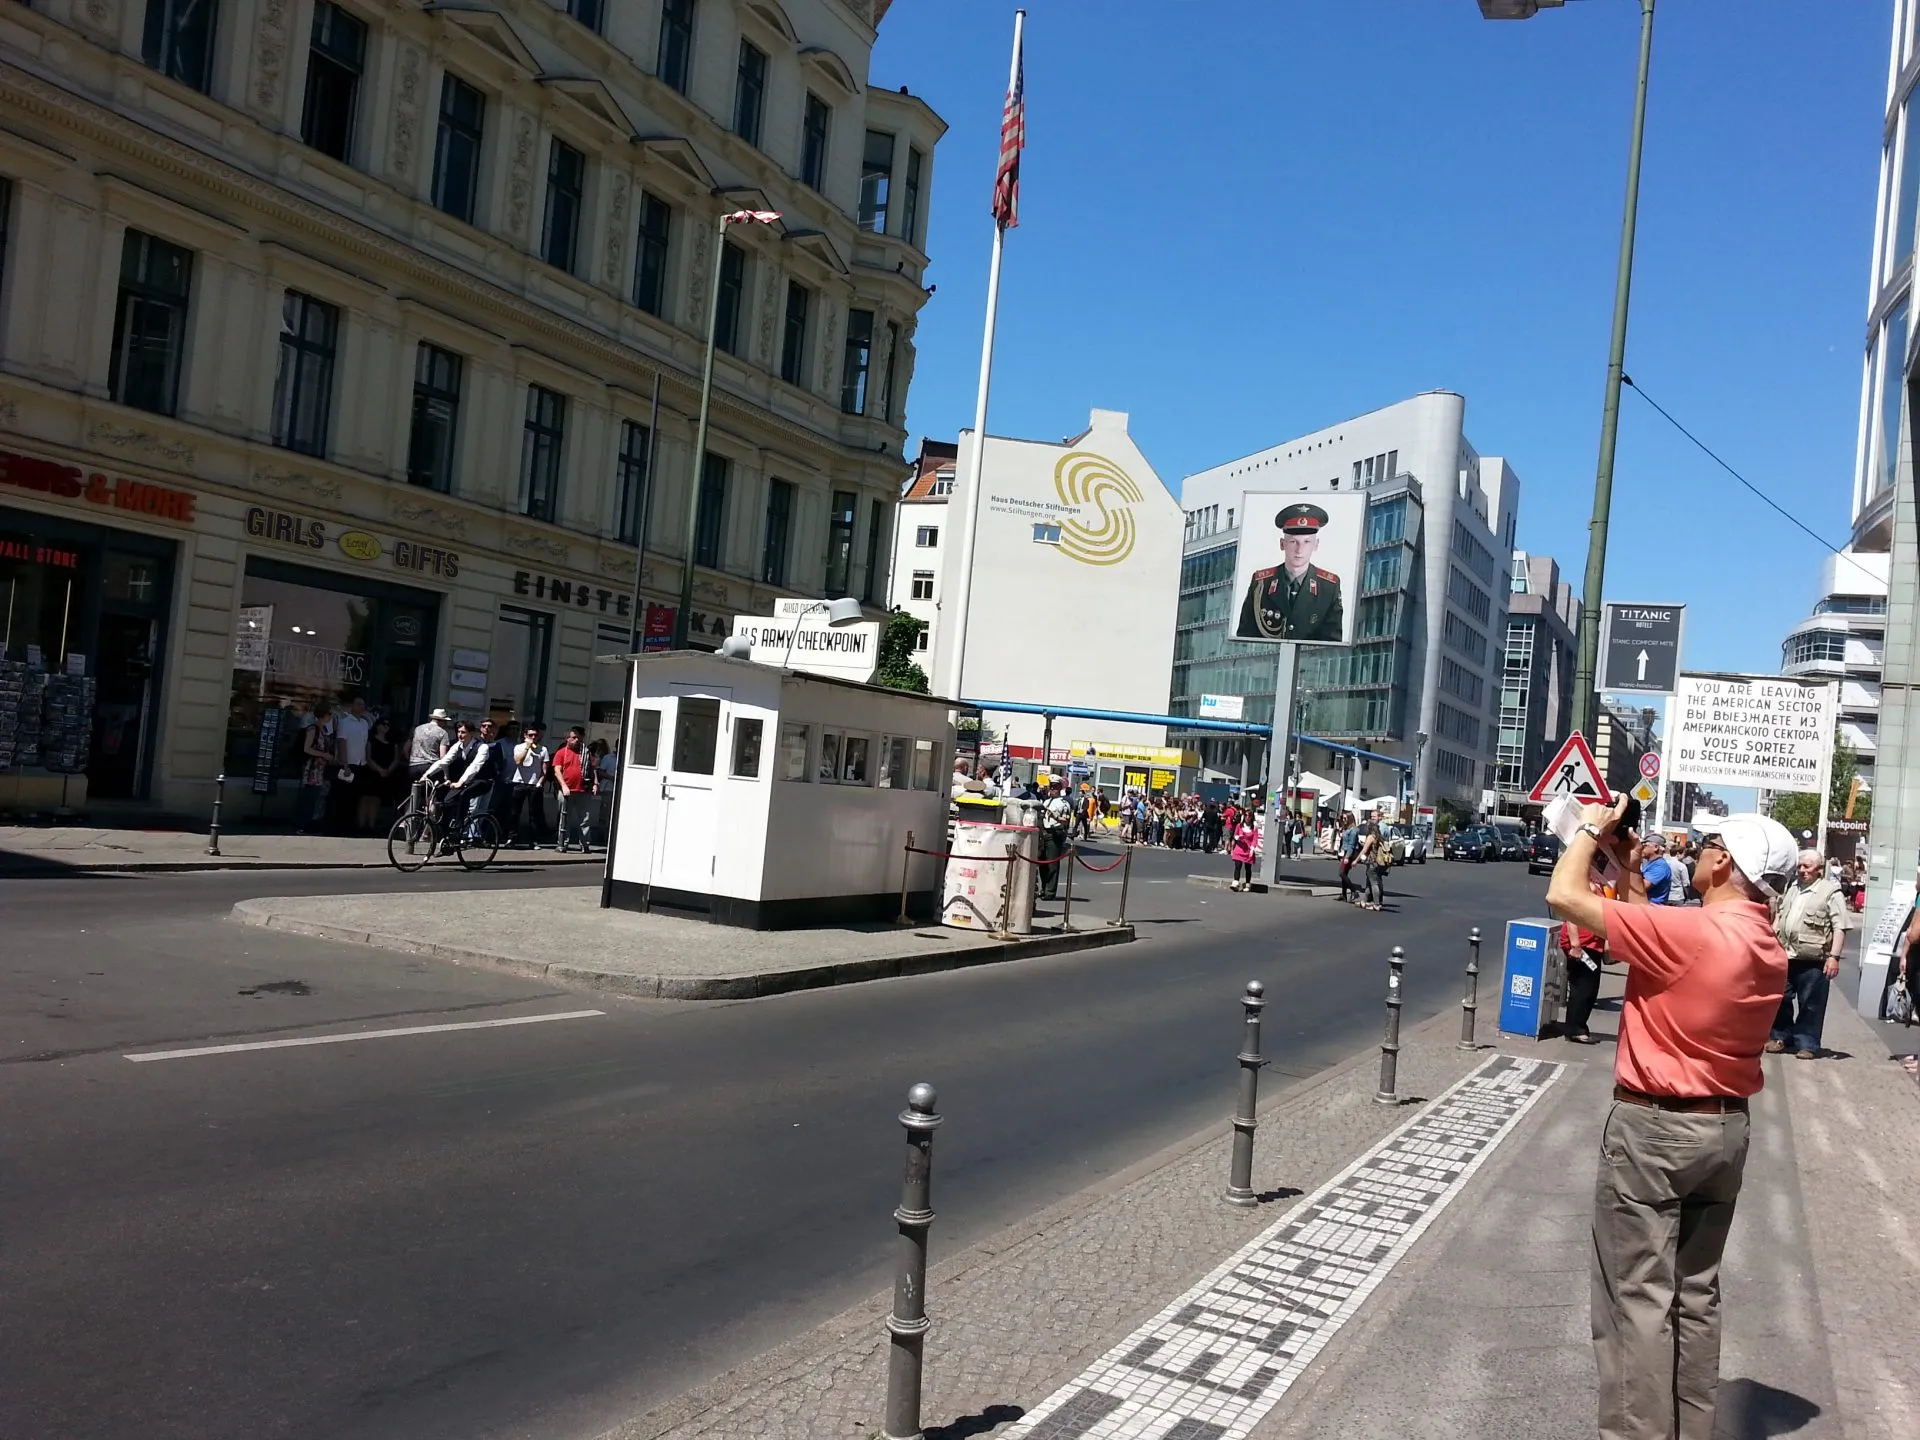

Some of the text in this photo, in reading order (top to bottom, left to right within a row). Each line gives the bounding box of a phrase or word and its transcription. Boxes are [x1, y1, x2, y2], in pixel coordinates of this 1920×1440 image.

[85, 473, 110, 504] &
[115, 478, 197, 523] MORE
[990, 495, 1081, 514] Haus Deutscher Stiftungen
[990, 506, 1056, 520] www.Stiftungen.org
[247, 508, 326, 549] GIRLS
[394, 541, 460, 578] GIFTS
[36, 546, 78, 569] STORE
[514, 570, 664, 619] EINSTEI
[1620, 609, 1671, 620] TITANIC
[761, 628, 793, 649] ARMY
[797, 630, 868, 653] CHECKPOINT
[1612, 638, 1631, 646] TITANIC
[1632, 639, 1659, 647] COMFORT
[1695, 682, 1816, 700] YOU ARE LEAVING
[1687, 694, 1822, 713] THE AMERICAN SECTOR
[1686, 708, 1817, 728] ВЫ ВЫЕЗЖАЕТЕ ИЗ
[1682, 721, 1820, 741] АМЕРИКАНСКОГО СЕКТОРА
[1703, 736, 1795, 755] VOUS SORTEZ
[1680, 749, 1695, 760] DU
[1700, 750, 1750, 765] SECTEUR
[1126, 771, 1147, 787] THE
[1679, 763, 1689, 773] SIE
[1689, 764, 1723, 775] VERLASSEN
[1724, 766, 1736, 776] DEN
[1792, 772, 1816, 783] SEKTOR
